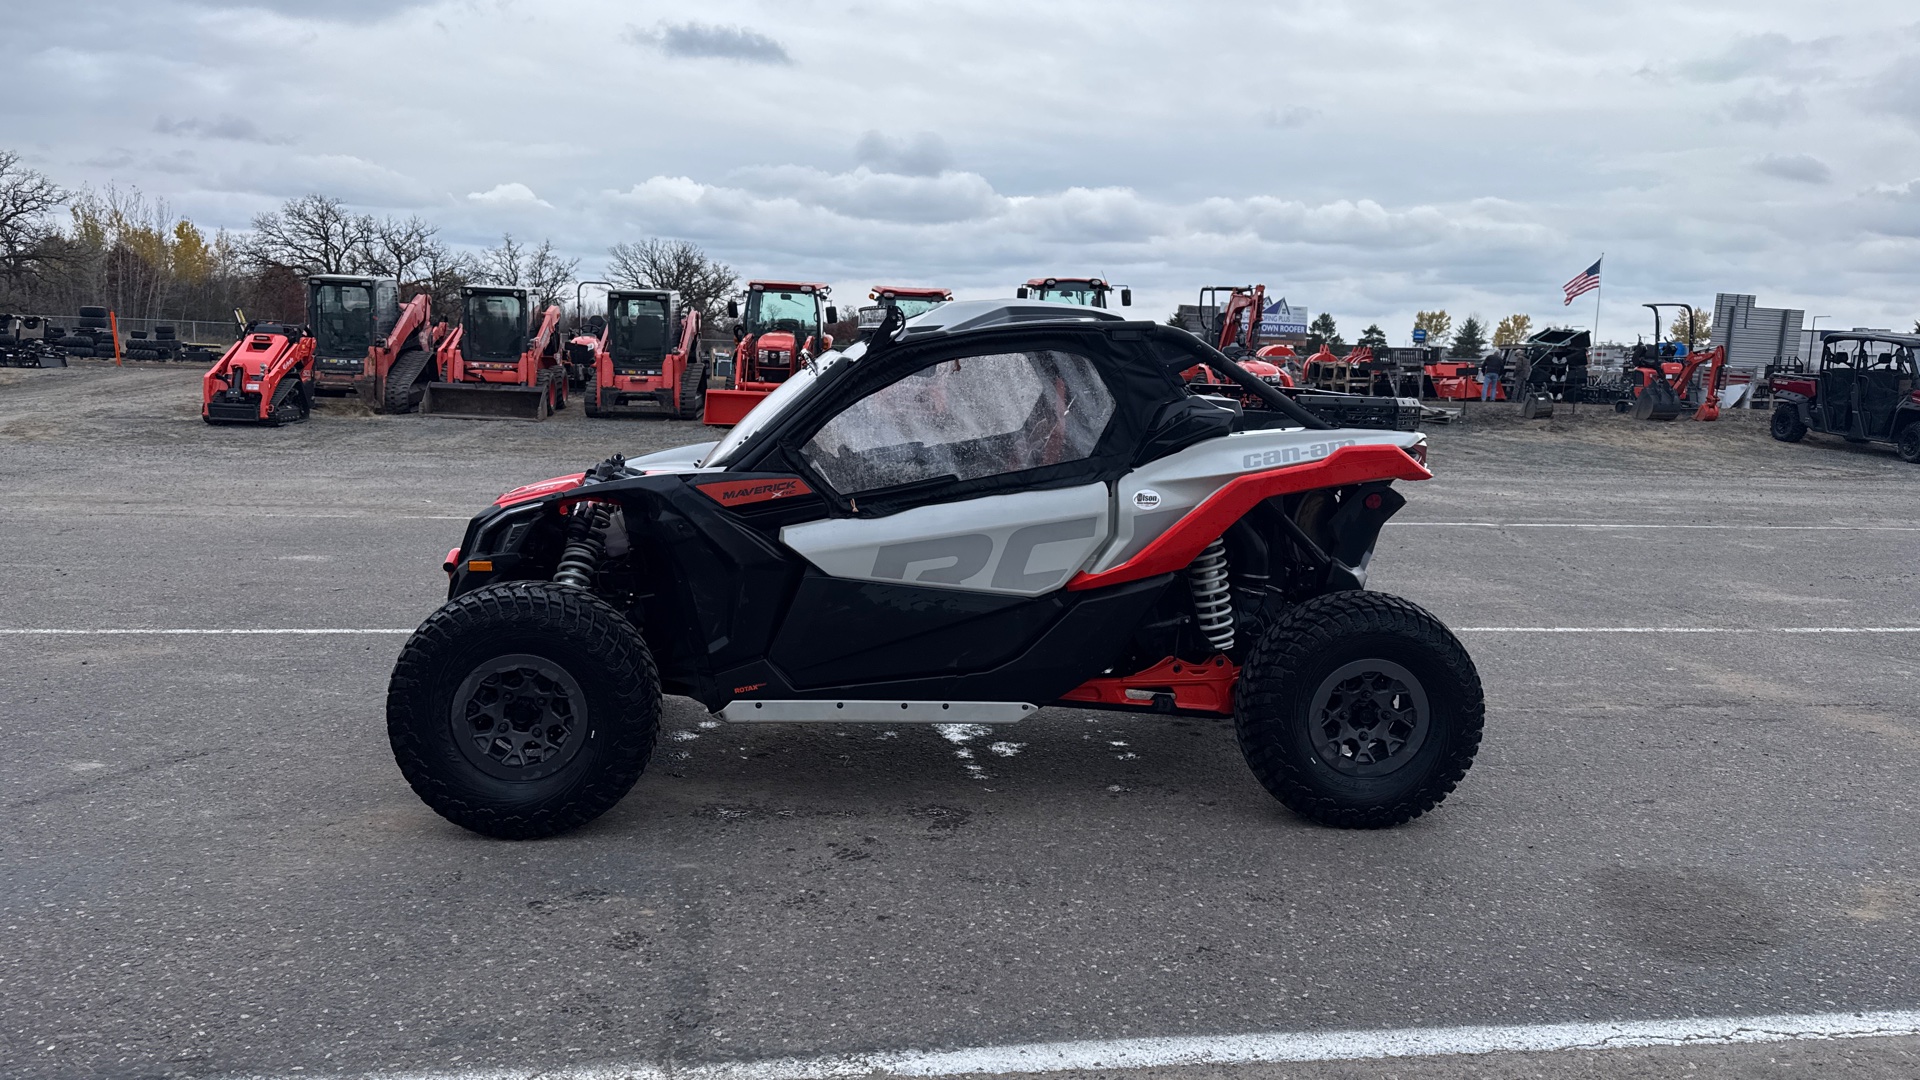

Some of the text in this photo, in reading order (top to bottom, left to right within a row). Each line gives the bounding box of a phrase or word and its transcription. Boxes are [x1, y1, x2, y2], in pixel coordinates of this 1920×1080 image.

[1280, 325, 1305, 333] ROOFER
[723, 481, 796, 499] MAVERICK
[1137, 493, 1157, 501] Olson
[734, 685, 758, 693] ROTAX
